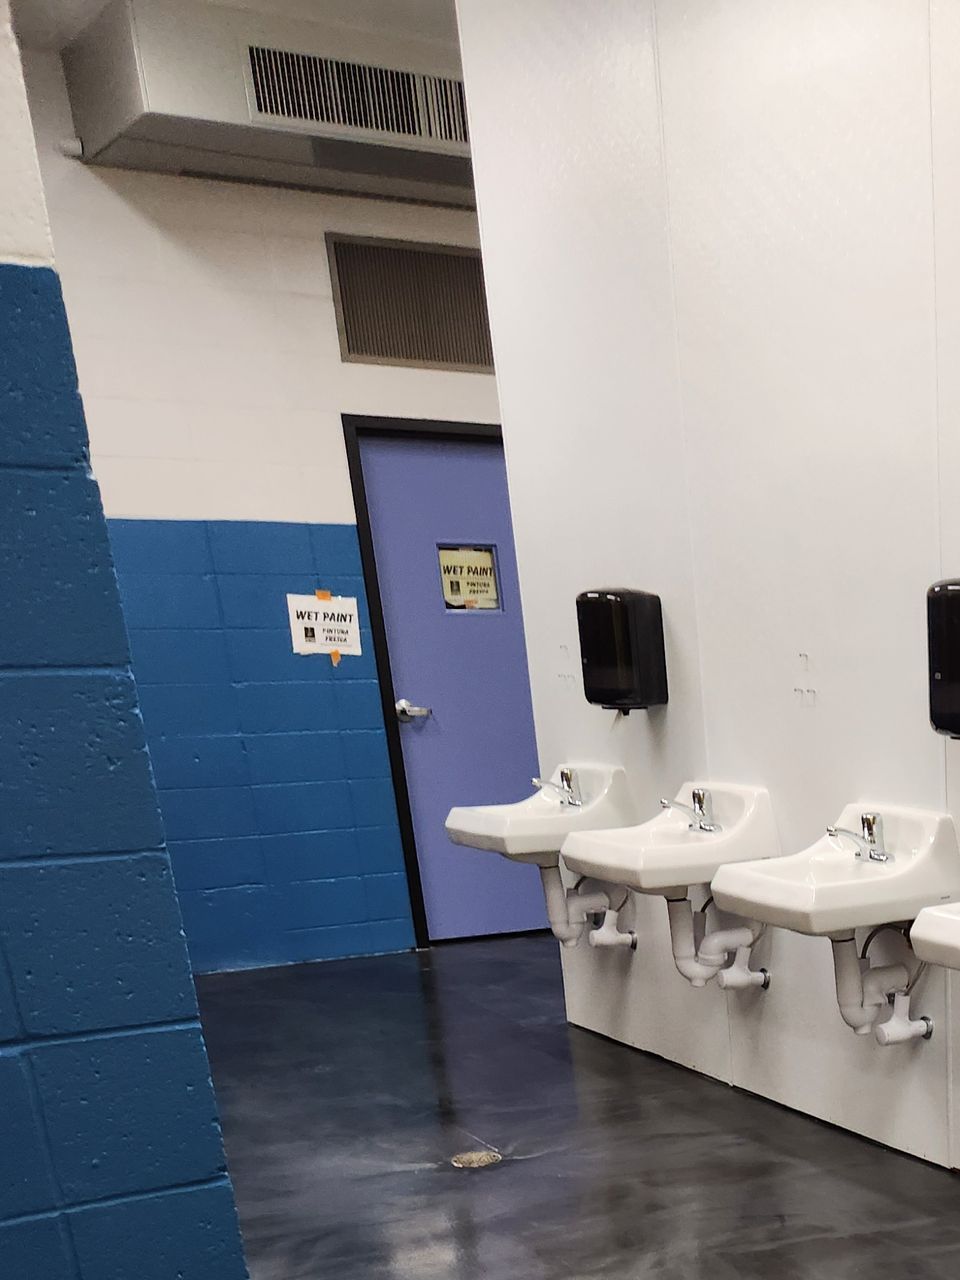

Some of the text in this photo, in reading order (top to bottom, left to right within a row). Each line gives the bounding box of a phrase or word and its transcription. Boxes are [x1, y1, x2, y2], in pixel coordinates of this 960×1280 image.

[442, 564, 493, 577] WET PAINT
[295, 609, 354, 624] WET PAINT
